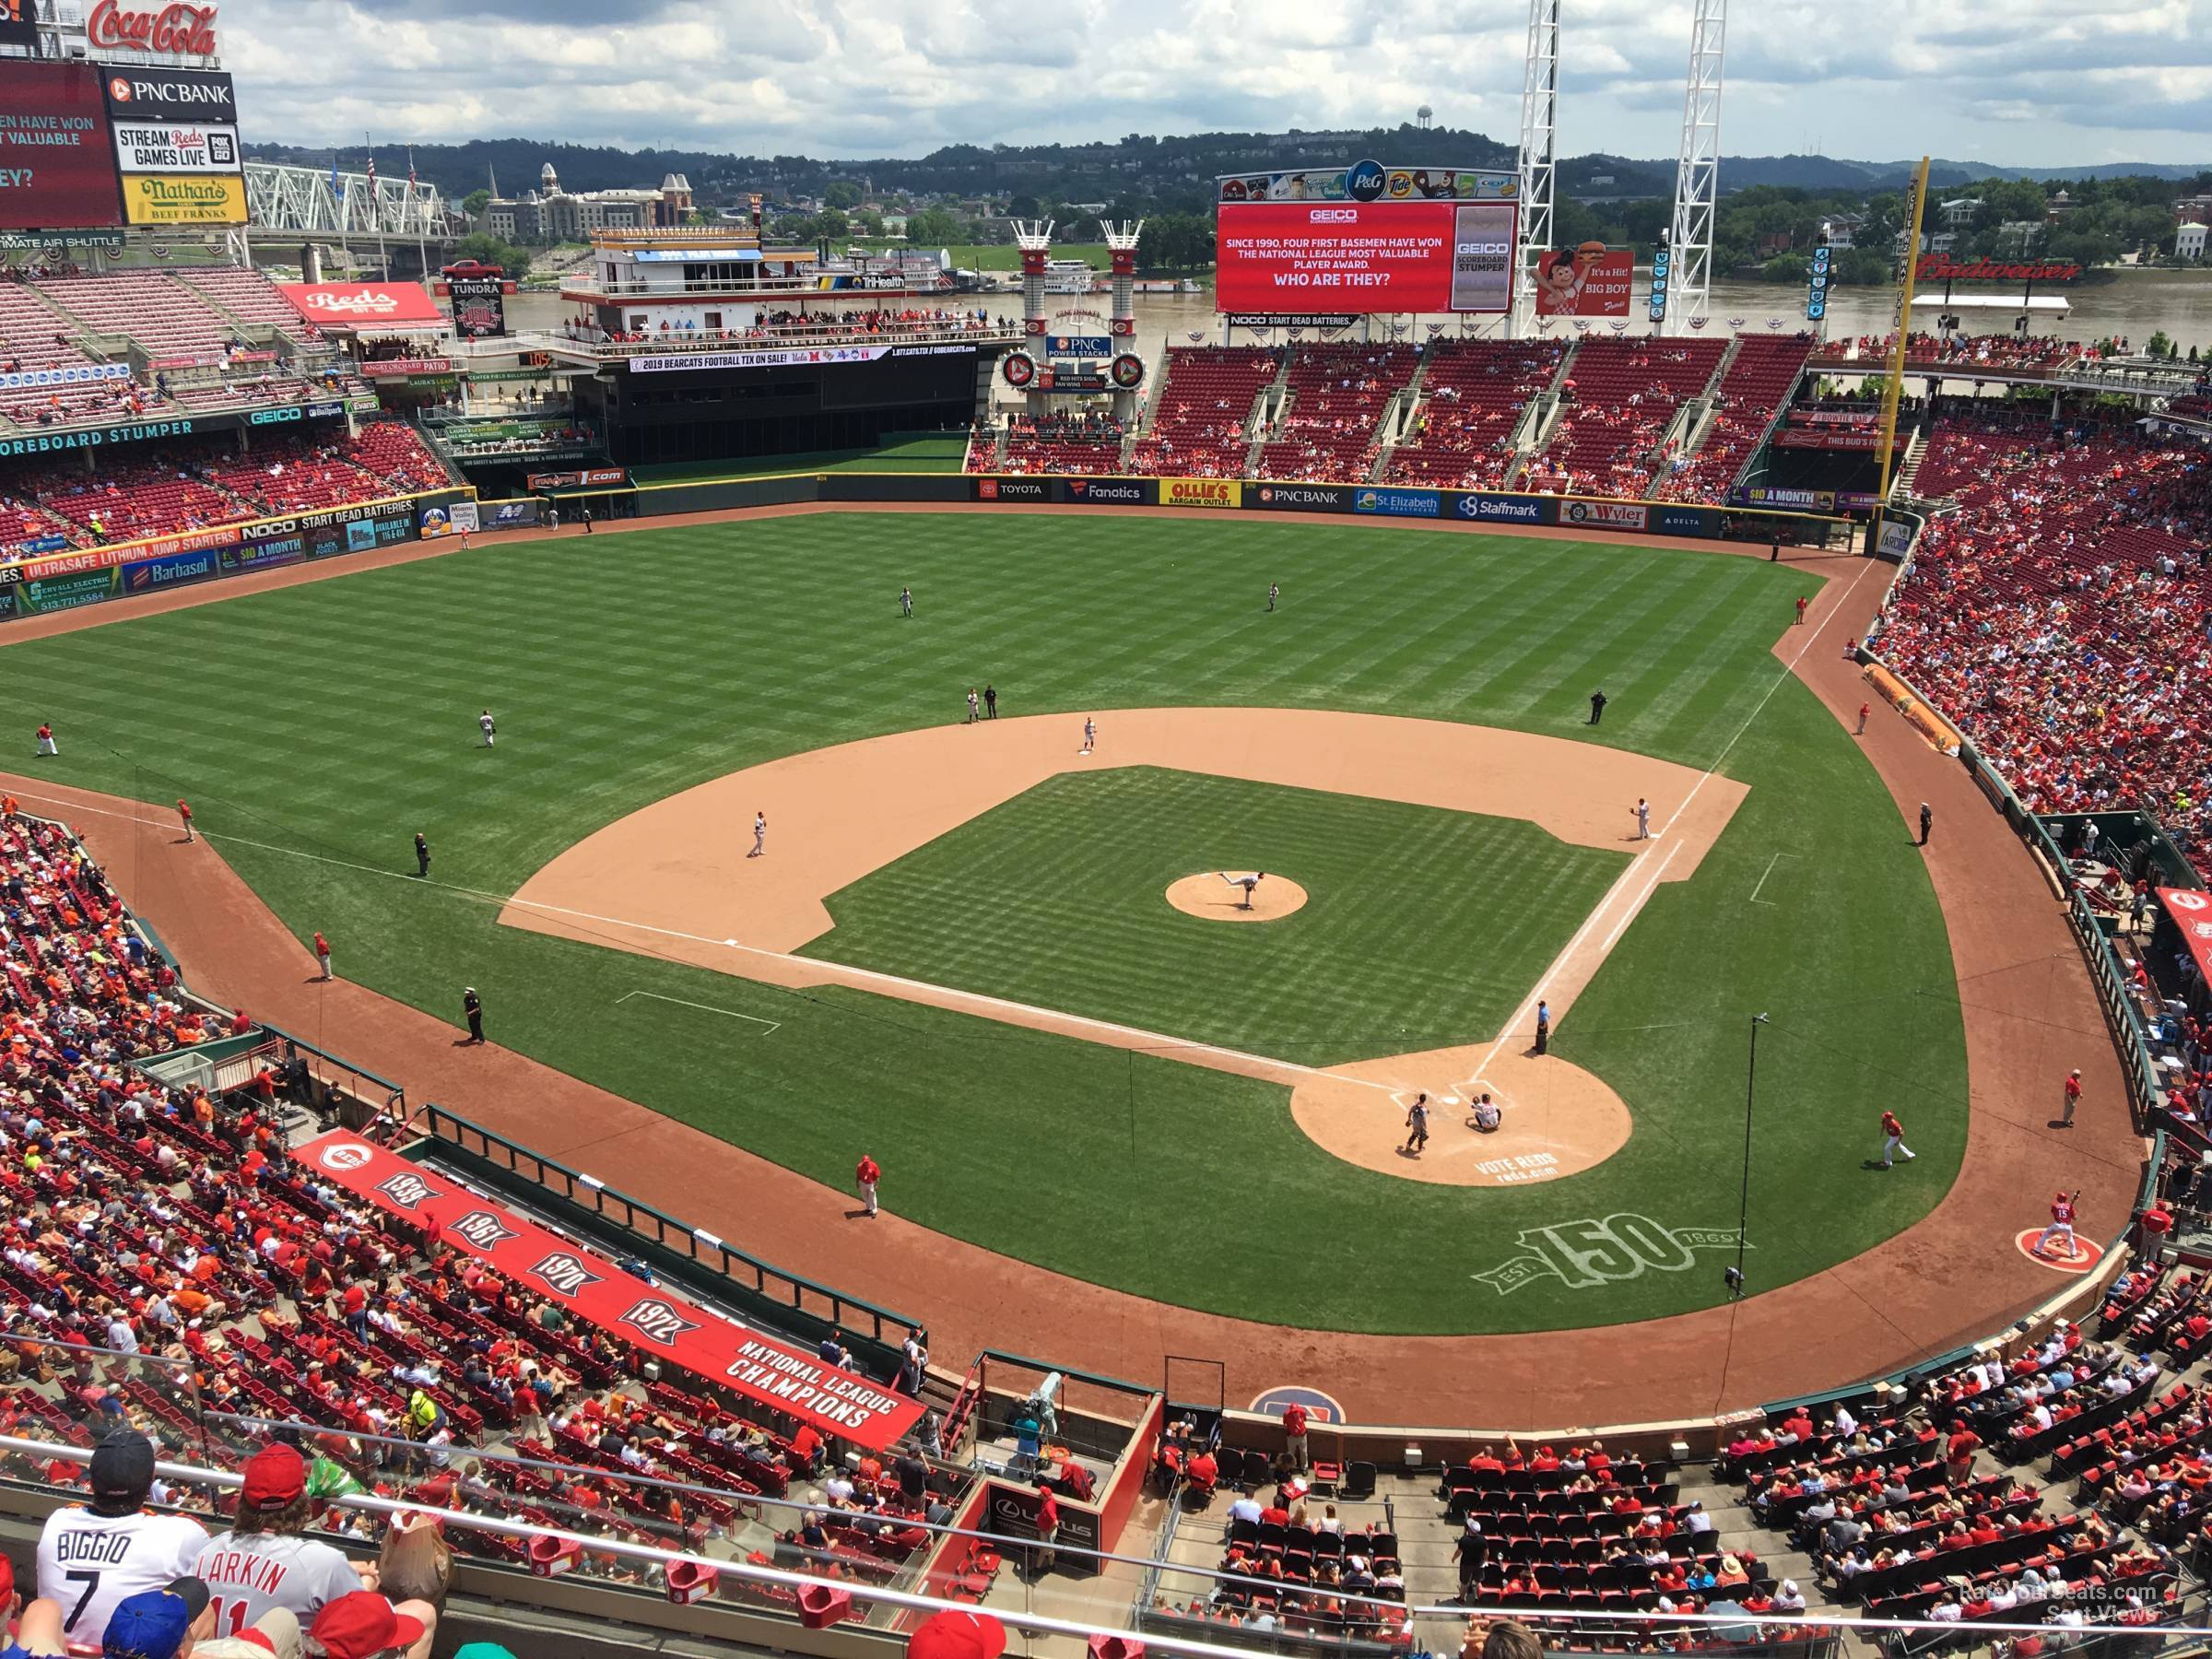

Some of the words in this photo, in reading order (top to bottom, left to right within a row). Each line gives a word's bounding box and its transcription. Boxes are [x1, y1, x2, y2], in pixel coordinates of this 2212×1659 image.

[88, 0, 218, 55] Coca-Cola
[20, 116, 55, 128] HAVE
[60, 117, 94, 129] WON
[8, 133, 80, 146] VALUABLE
[121, 130, 170, 146] STREAM
[171, 128, 205, 148] Reds
[211, 137, 229, 147] FOX
[135, 149, 178, 166] GAMES
[181, 150, 205, 165] LIVE
[214, 150, 229, 160] GO
[1355, 173, 1383, 189] P&G
[1389, 178, 1411, 194] Tide
[142, 180, 228, 201] Nathan's
[152, 210, 180, 219] BEEF
[183, 209, 227, 218] FRANKS
[1310, 209, 1357, 220] GEICO
[43, 239, 64, 248] AIR
[66, 237, 121, 247] SHUTTLE
[1226, 239, 1254, 248] SINCE
[1255, 239, 1282, 249] 1990,
[1283, 239, 1310, 248] FOUR
[1312, 239, 1338, 247] FIRST
[1340, 239, 1387, 247] BASEMEN
[1388, 238, 1415, 247] HAVE
[1418, 238, 1442, 247] WON
[1457, 242, 1509, 254] GEICO
[1238, 250, 1257, 258] THE
[1259, 250, 1308, 258] NATIONAL
[1310, 250, 1347, 258] LEAGUE
[1348, 250, 1376, 258] MOST
[1378, 250, 1430, 258] VALUABLE
[1457, 255, 1508, 264] SCOREBOARD
[1294, 261, 1331, 269] PLAYER
[1333, 260, 1370, 269] AWARD.
[1458, 264, 1505, 273] STUMPER
[1592, 267, 1604, 276] It's
[1612, 267, 1628, 276] Hit!
[1915, 253, 2082, 281] Budweiser
[1274, 273, 1310, 286] WHO
[1312, 273, 1341, 286] ARE
[1344, 273, 1391, 286] THEY?
[1900, 258, 1909, 288] WAY
[453, 284, 499, 294] TUNDRA
[863, 276, 904, 288] TriHealth
[1585, 284, 1604, 294] BIG
[1606, 284, 1629, 294] BOY
[306, 289, 398, 312] Reds
[1894, 291, 1903, 327] FAIR
[1230, 316, 1266, 324] NOCO
[1268, 316, 1290, 324] START
[1291, 316, 1310, 324] DEAD
[1312, 316, 1351, 325] BATTERIES.
[934, 345, 976, 354] GOBEARCATS.com
[1070, 338, 1100, 350] PNC
[365, 363, 387, 371] ANGRY
[387, 360, 421, 371] ORCHARD
[423, 361, 447, 371] PATIO
[643, 360, 663, 370] 2019
[665, 358, 702, 369] BEARCATS
[704, 356, 740, 368] FOOTBALL
[742, 355, 754, 365] TIX
[756, 354, 765, 364] ON
[767, 353, 787, 364] SALE!
[409, 379, 435, 387] LAURA'S
[316, 406, 343, 417] Ballpark
[352, 400, 376, 411] Evans
[251, 407, 301, 425] GEICO
[1822, 414, 1849, 422] BOWTIE
[1852, 414, 1867, 423] BAR
[110, 420, 193, 442] STUMPER
[1828, 437, 1844, 445] THIS
[1845, 437, 1868, 446] BUD'S
[1869, 438, 1883, 447] FOR
[1001, 485, 1041, 494] TOYOTA
[1088, 485, 1140, 499] Fanatics
[1749, 488, 1766, 500] $10
[1767, 490, 1774, 500] A
[1775, 491, 1814, 503] MONTH
[1391, 496, 1437, 508] Elizabeth
[1480, 500, 1536, 517] Staffmark
[242, 521, 296, 540] NOCO
[302, 512, 333, 530] START
[336, 508, 361, 524] DEAD
[364, 500, 415, 519] BATTERIES.
[1595, 504, 1643, 521] Wyler
[375, 520, 401, 533] AVAILABLE
[401, 518, 409, 528] IN
[1673, 517, 1700, 526] DELTA
[29, 554, 98, 578] ULTRASAFE
[100, 548, 147, 566] LITHIUM
[149, 542, 180, 557] JUMP
[182, 529, 238, 551] STARTERS.
[241, 547, 256, 560] $10
[258, 546, 265, 557] A
[266, 538, 301, 555] MONTH
[153, 557, 207, 582] Barbasol
[74, 576, 110, 589] ELECTRIC
[41, 592, 103, 610] 513.771.5584
[335, 1150, 366, 1167] REDS
[1474, 1159, 1517, 1176] VOTE
[1516, 1152, 1559, 1169] REDS
[1496, 1166, 1558, 1183] reds.com
[382, 1174, 428, 1204] 1939
[2058, 1210, 2068, 1218] 15
[456, 1213, 505, 1243] 1961
[1682, 1232, 1735, 1244] 1869
[1515, 1213, 1696, 1288] 150
[535, 1253, 585, 1290] 1970
[1498, 1263, 1537, 1284] EST.
[629, 1300, 682, 1339] 1972
[736, 1340, 825, 1384] NATIONAL
[821, 1375, 899, 1415] LEAGUE
[725, 1359, 871, 1428] CHAMPIONS
[57, 1532, 132, 1565] BIGGIO
[195, 1550, 288, 1597] LARKIN
[64, 1570, 100, 1634] 7
